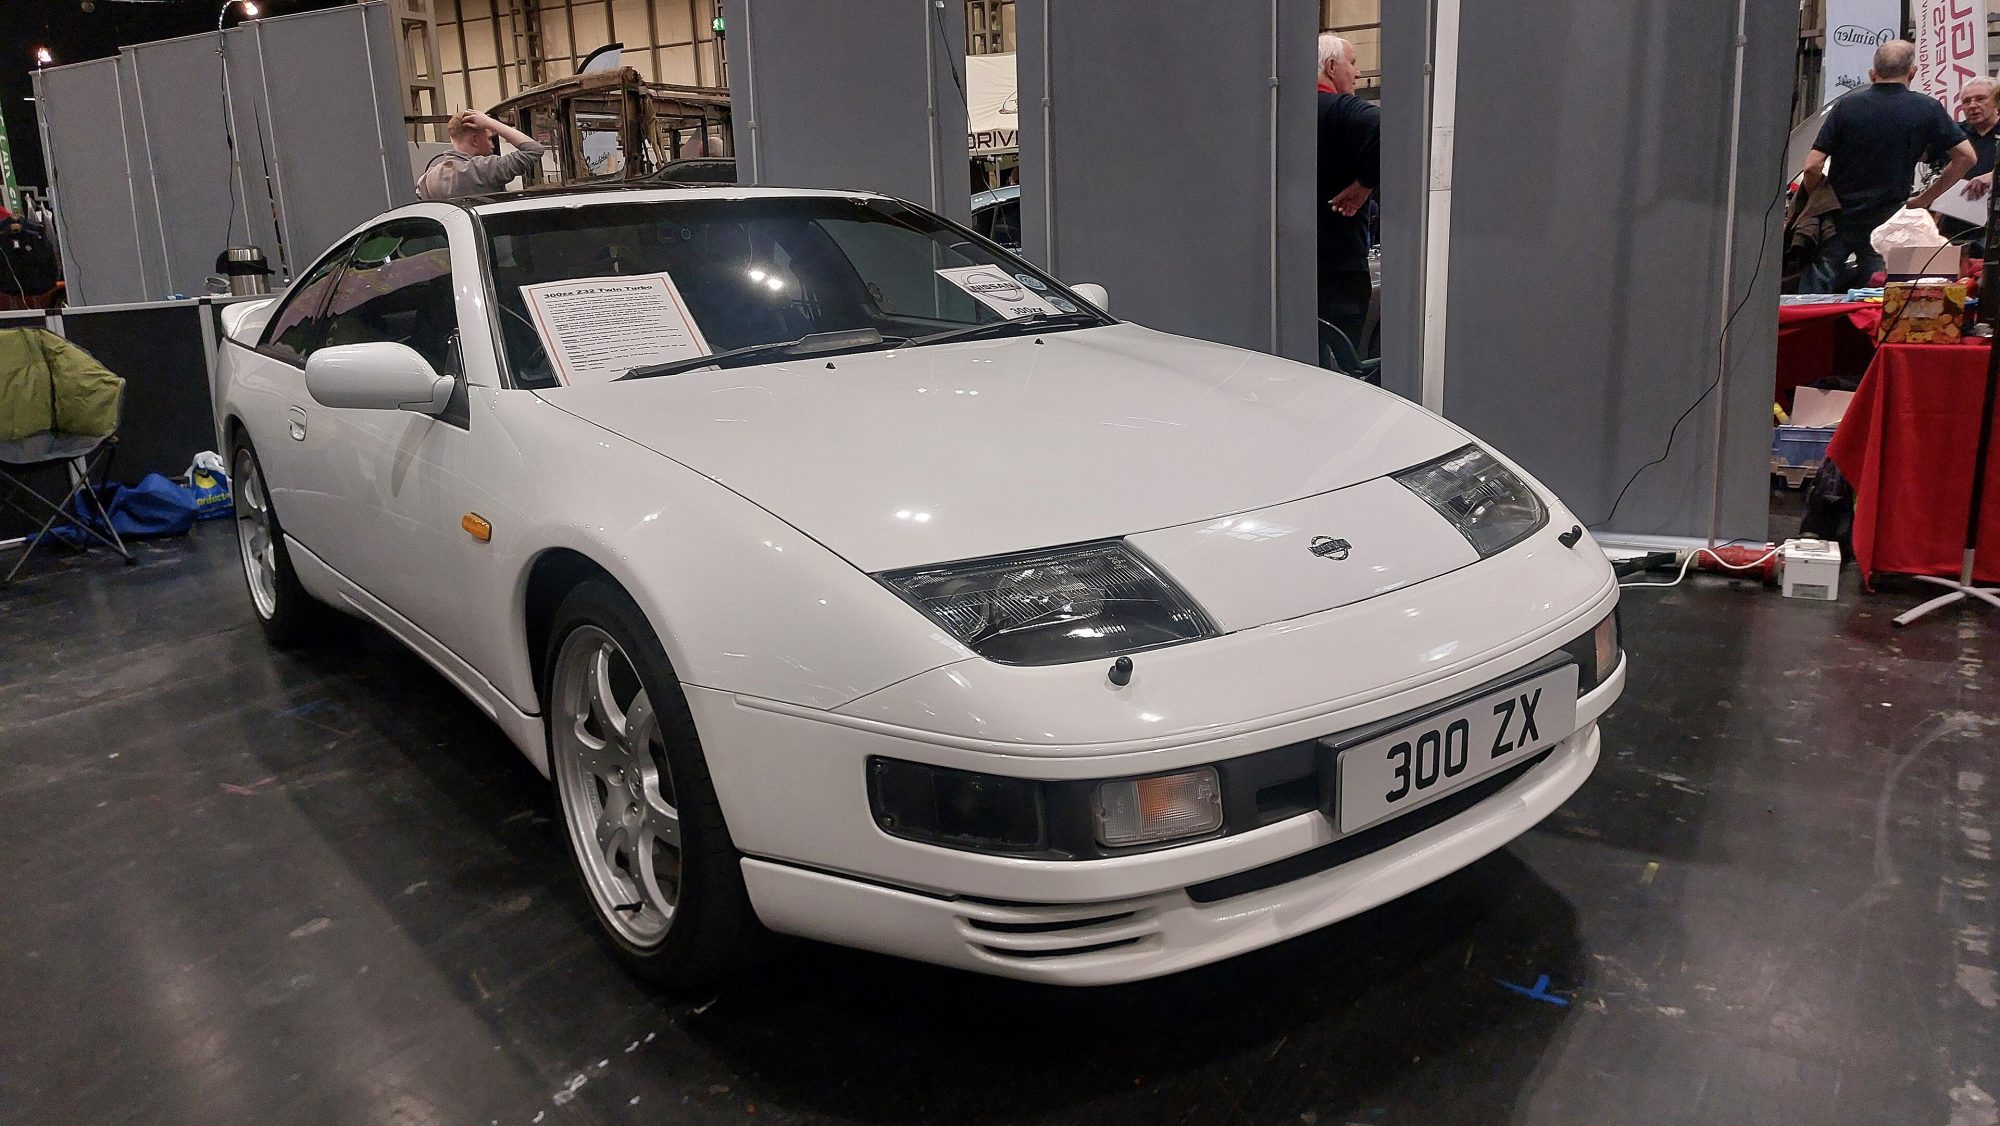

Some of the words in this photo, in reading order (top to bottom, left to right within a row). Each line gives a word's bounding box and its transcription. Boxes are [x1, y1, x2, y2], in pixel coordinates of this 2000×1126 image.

[970, 282, 1015, 291] NISSAN
[544, 291, 573, 299] 300zx
[1385, 718, 1469, 803] 300
[1491, 687, 1542, 760] ZX
